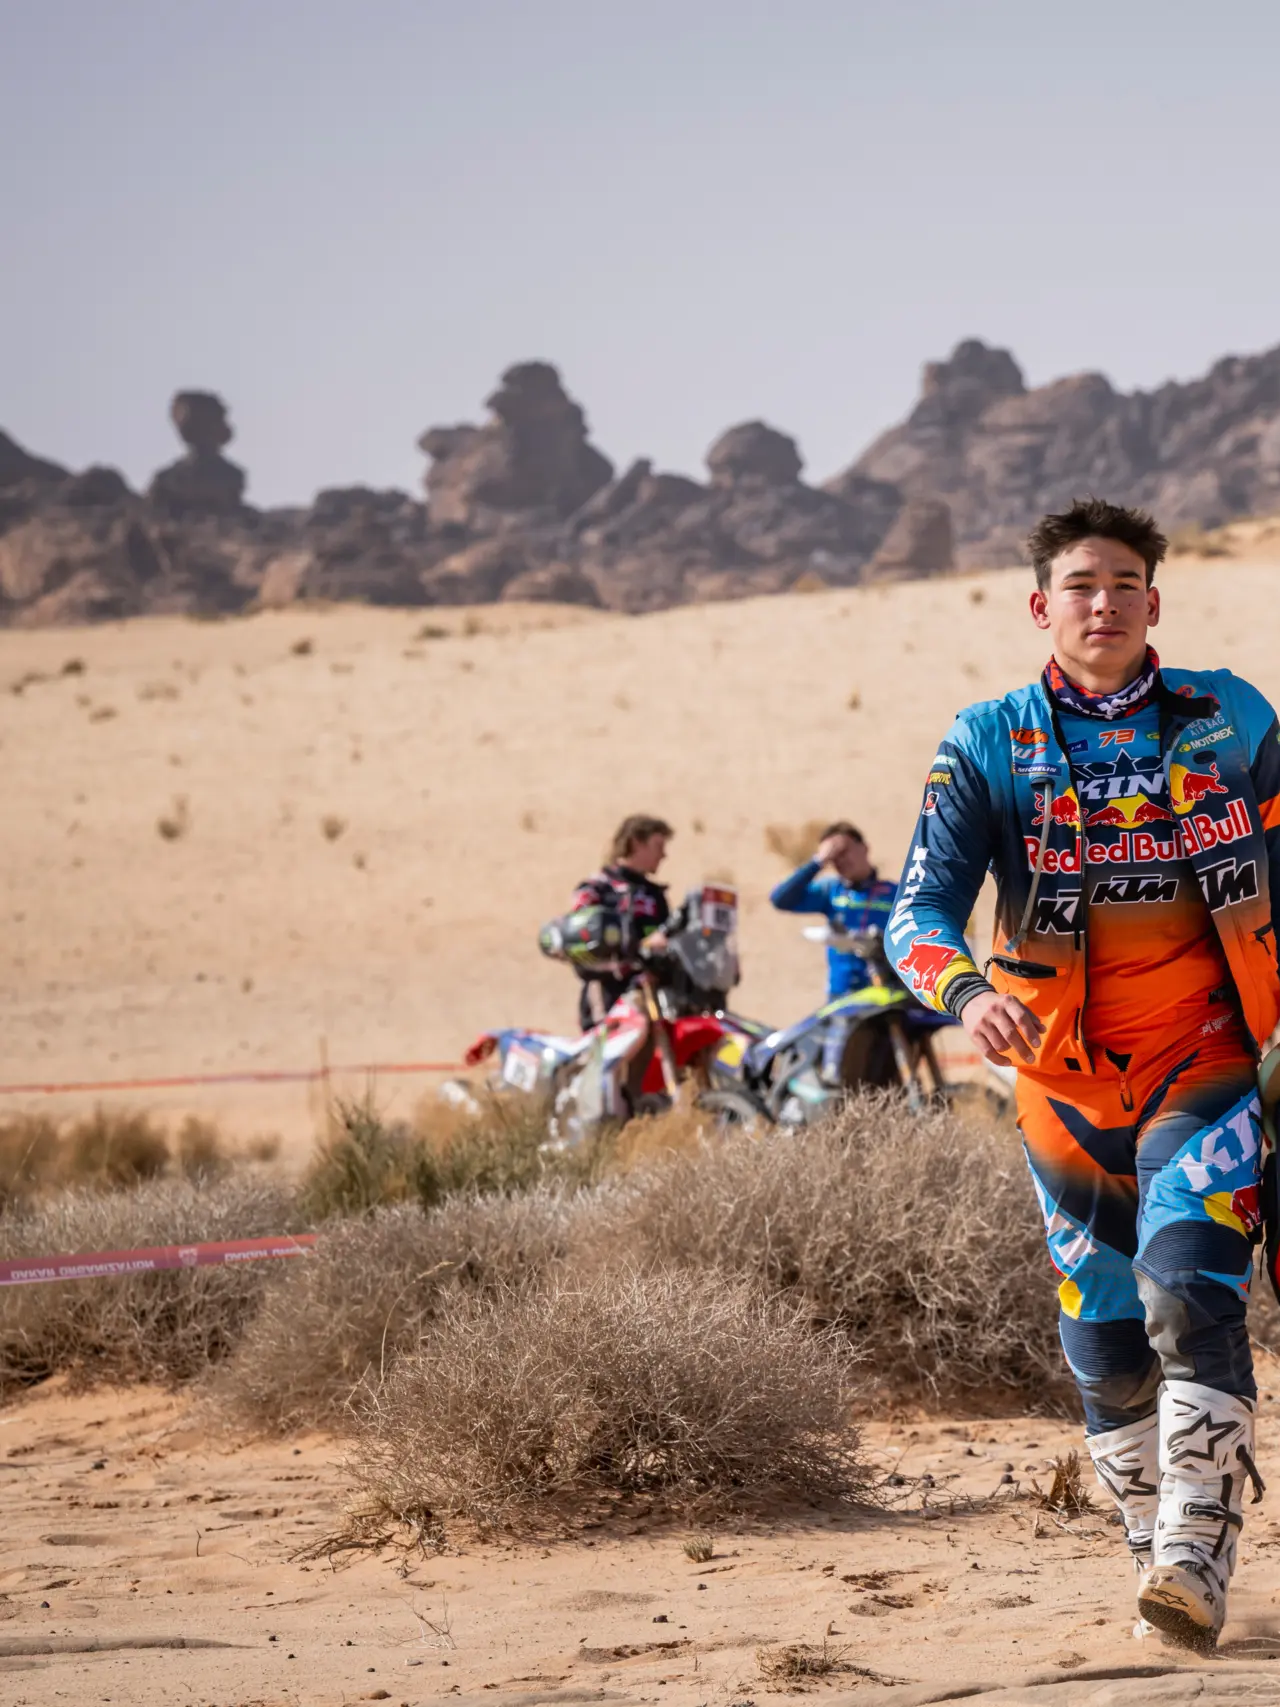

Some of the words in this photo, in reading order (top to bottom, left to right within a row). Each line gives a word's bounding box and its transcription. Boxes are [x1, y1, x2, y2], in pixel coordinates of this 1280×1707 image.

[1205, 715, 1226, 730] BAG
[1098, 728, 1137, 749] 73
[1189, 725, 1234, 750] MOTOREX
[1017, 765, 1057, 774] MICHELIN
[1075, 772, 1168, 801] KIN
[1193, 797, 1253, 850] Bull
[1084, 832, 1129, 864] ed
[888, 845, 930, 947] KINI
[1089, 874, 1180, 906] KTM
